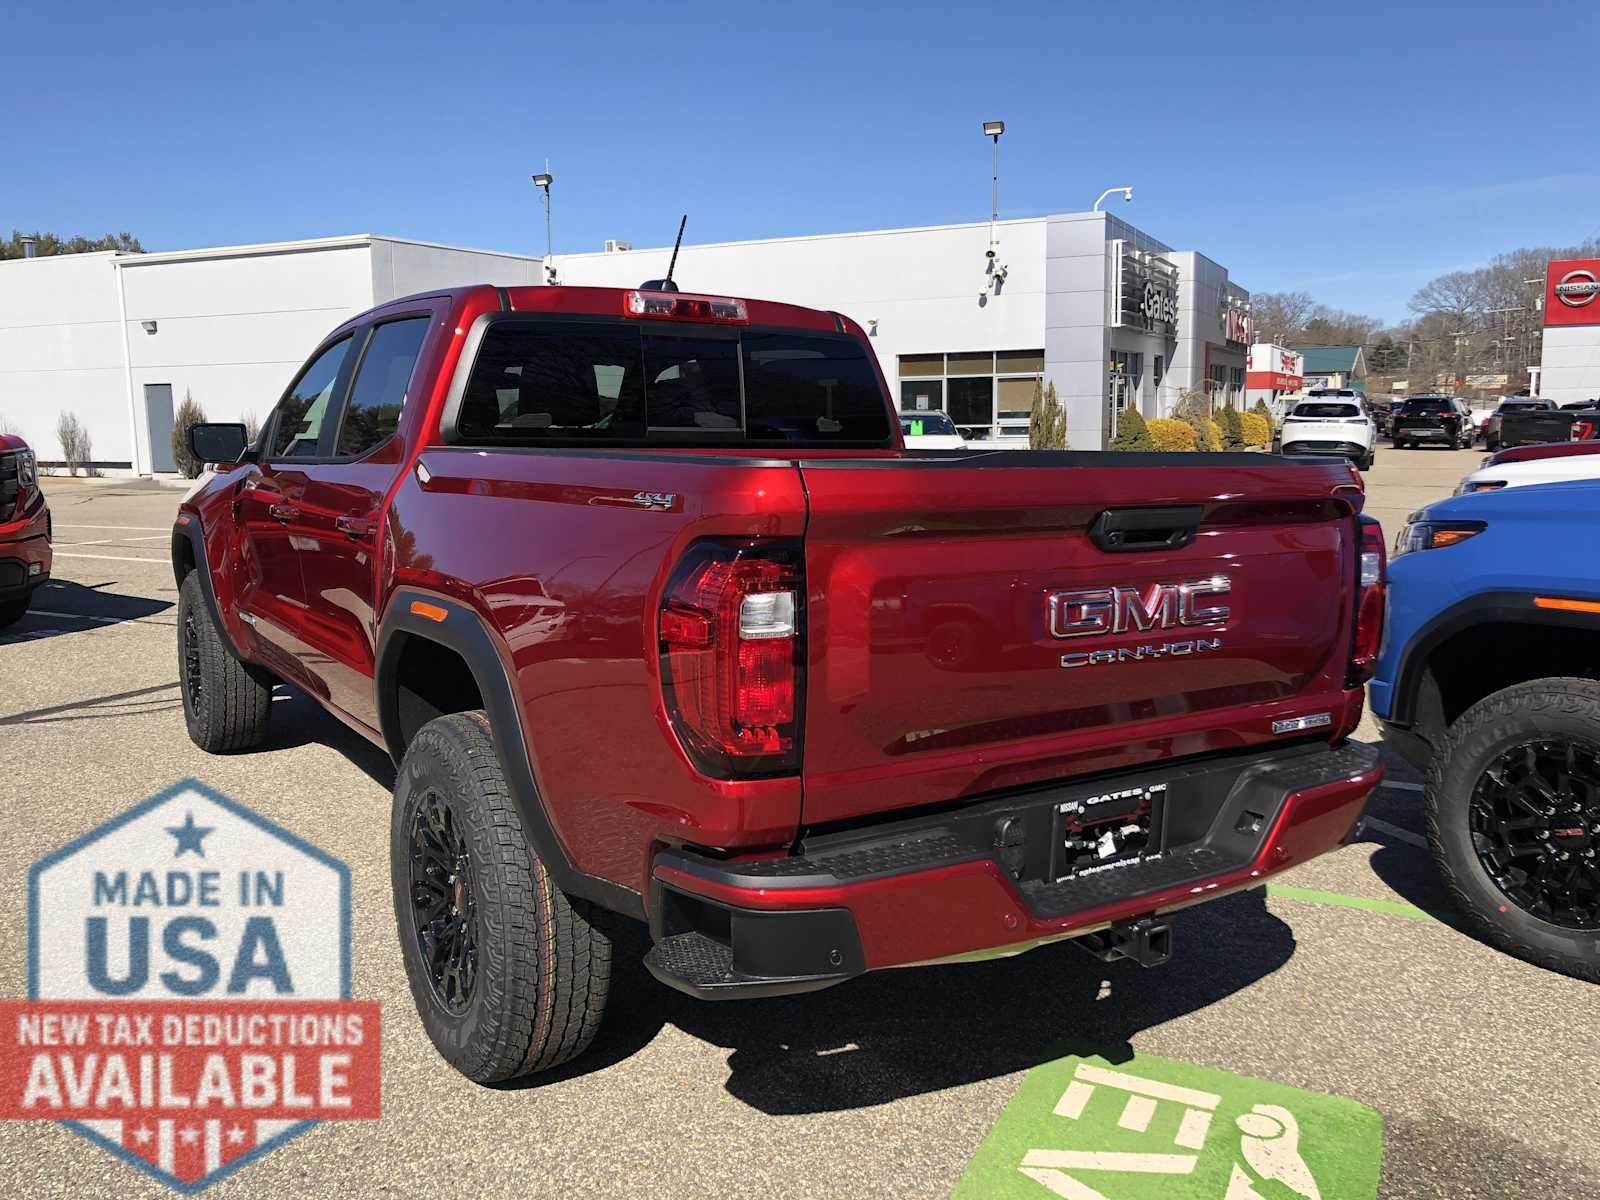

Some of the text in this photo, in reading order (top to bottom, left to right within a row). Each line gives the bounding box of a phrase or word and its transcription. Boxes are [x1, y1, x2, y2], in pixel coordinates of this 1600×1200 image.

[1144, 282, 1175, 324] Gates
[1559, 284, 1600, 294] NISSAN
[1048, 576, 1232, 638] GMC
[1060, 638, 1221, 668] CANYON
[1086, 788, 1143, 804] GATES
[1149, 784, 1167, 793] GMC
